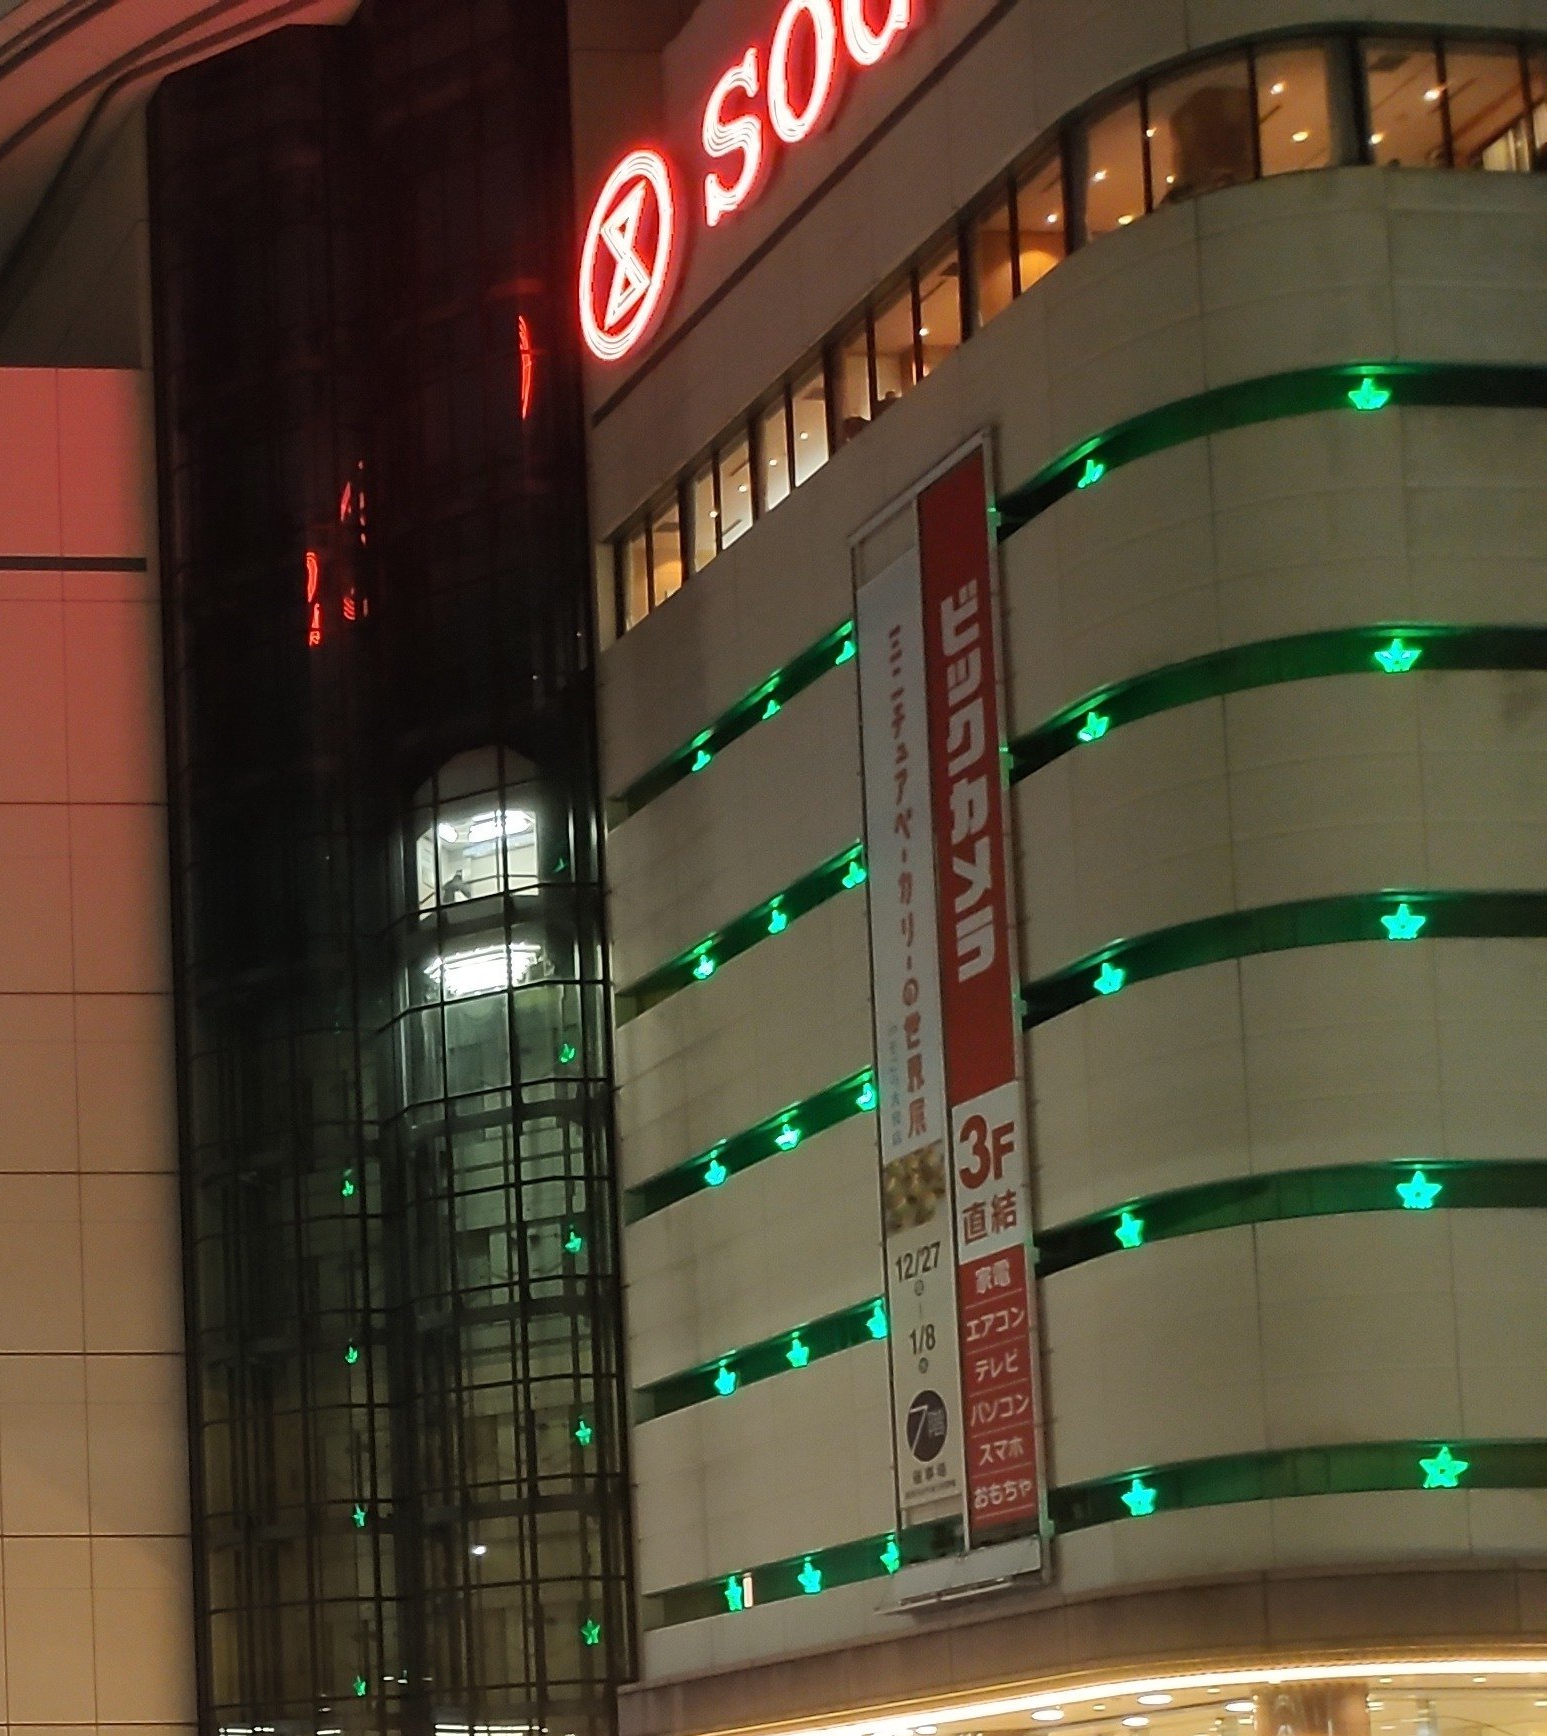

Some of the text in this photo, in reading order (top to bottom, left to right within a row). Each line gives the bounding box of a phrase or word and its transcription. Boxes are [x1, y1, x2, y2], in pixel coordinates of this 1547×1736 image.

[958, 1115, 1016, 1190] 3F
[962, 1191, 1018, 1246] 直結
[895, 1241, 941, 1283] 12/27
[909, 1324, 936, 1355] 1/8
[966, 1307, 1025, 1342] エアコン
[974, 1353, 1019, 1382] テレビ
[970, 1394, 1029, 1428] パソコン
[979, 1436, 1024, 1466] スマホ
[973, 1479, 1033, 1509] おもちゃ
